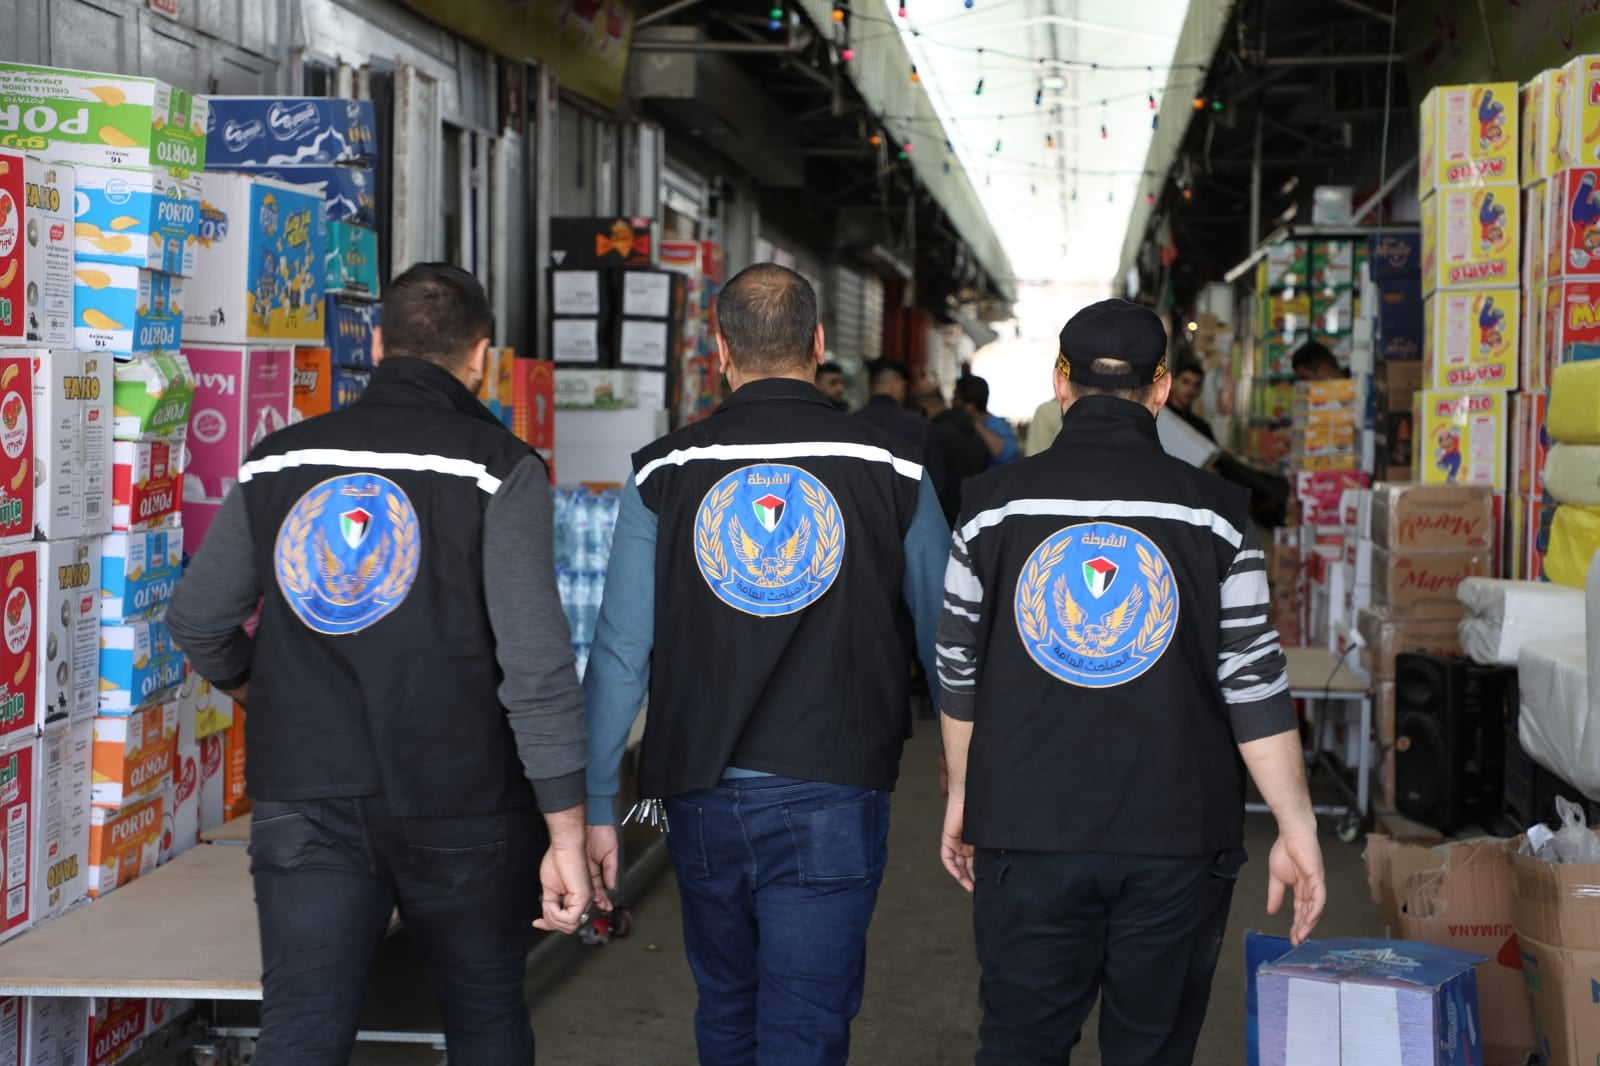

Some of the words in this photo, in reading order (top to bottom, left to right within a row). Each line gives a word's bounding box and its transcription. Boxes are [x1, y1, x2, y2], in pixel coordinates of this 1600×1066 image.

[157, 141, 198, 166] PORTO
[1448, 158, 1505, 181] MARIO
[158, 201, 195, 223] PORTO
[1449, 260, 1506, 283] MARIO
[95, 339, 107, 347] 16
[140, 326, 175, 346] PORTO
[1449, 364, 1505, 385] MARIO
[63, 376, 101, 400] TAKO
[152, 401, 187, 427] PORTO
[748, 473, 790, 487] الشرطة
[140, 489, 173, 517] PORTO
[1081, 532, 1127, 549] الشرطة
[58, 562, 90, 590] TAKO
[134, 578, 175, 609] PORTO
[735, 580, 766, 601] العامة
[767, 578, 808, 601] المباحث
[1053, 646, 1084, 669] العامة
[1085, 651, 1131, 672] المباحث
[141, 662, 180, 697] PORTO
[130, 751, 169, 788] PORTO
[111, 806, 155, 844] PORTO
[46, 854, 78, 890] TAKO
[1447, 924, 1513, 937] JUMANA
[95, 1013, 139, 1060] PORTO
